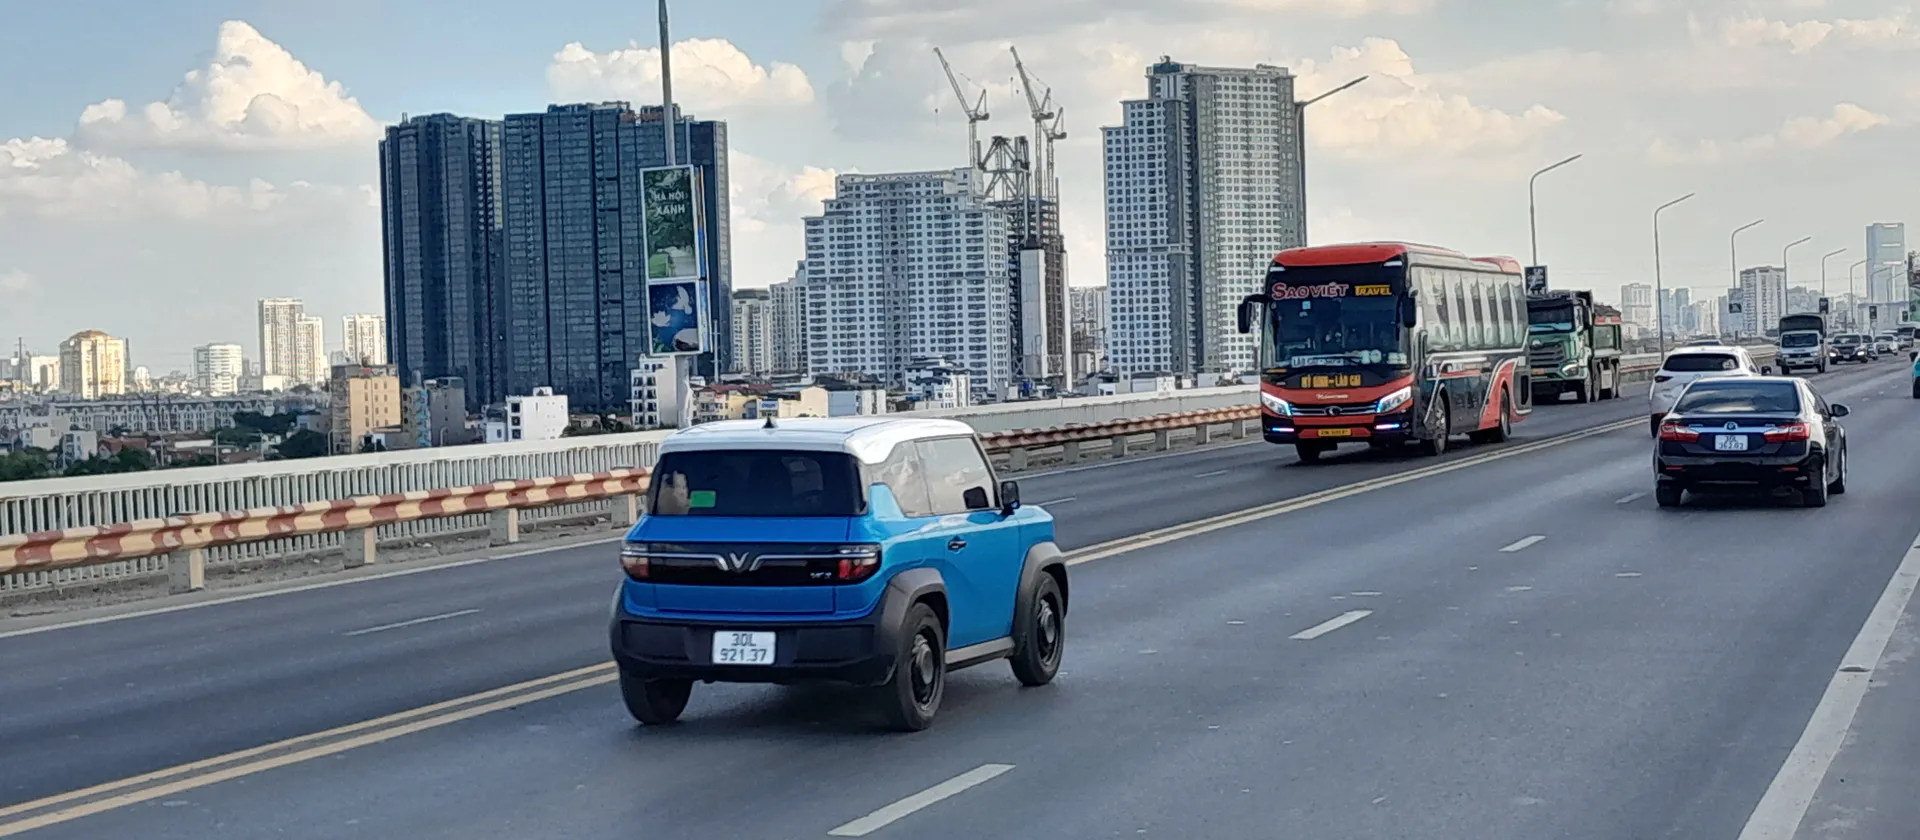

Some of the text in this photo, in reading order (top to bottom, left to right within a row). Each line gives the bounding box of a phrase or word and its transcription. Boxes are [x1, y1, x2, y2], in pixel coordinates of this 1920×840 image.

[654, 203, 686, 217] XANH
[1354, 284, 1392, 296] TRAVEL
[731, 633, 757, 647] 30L
[720, 648, 767, 662] 921.37
